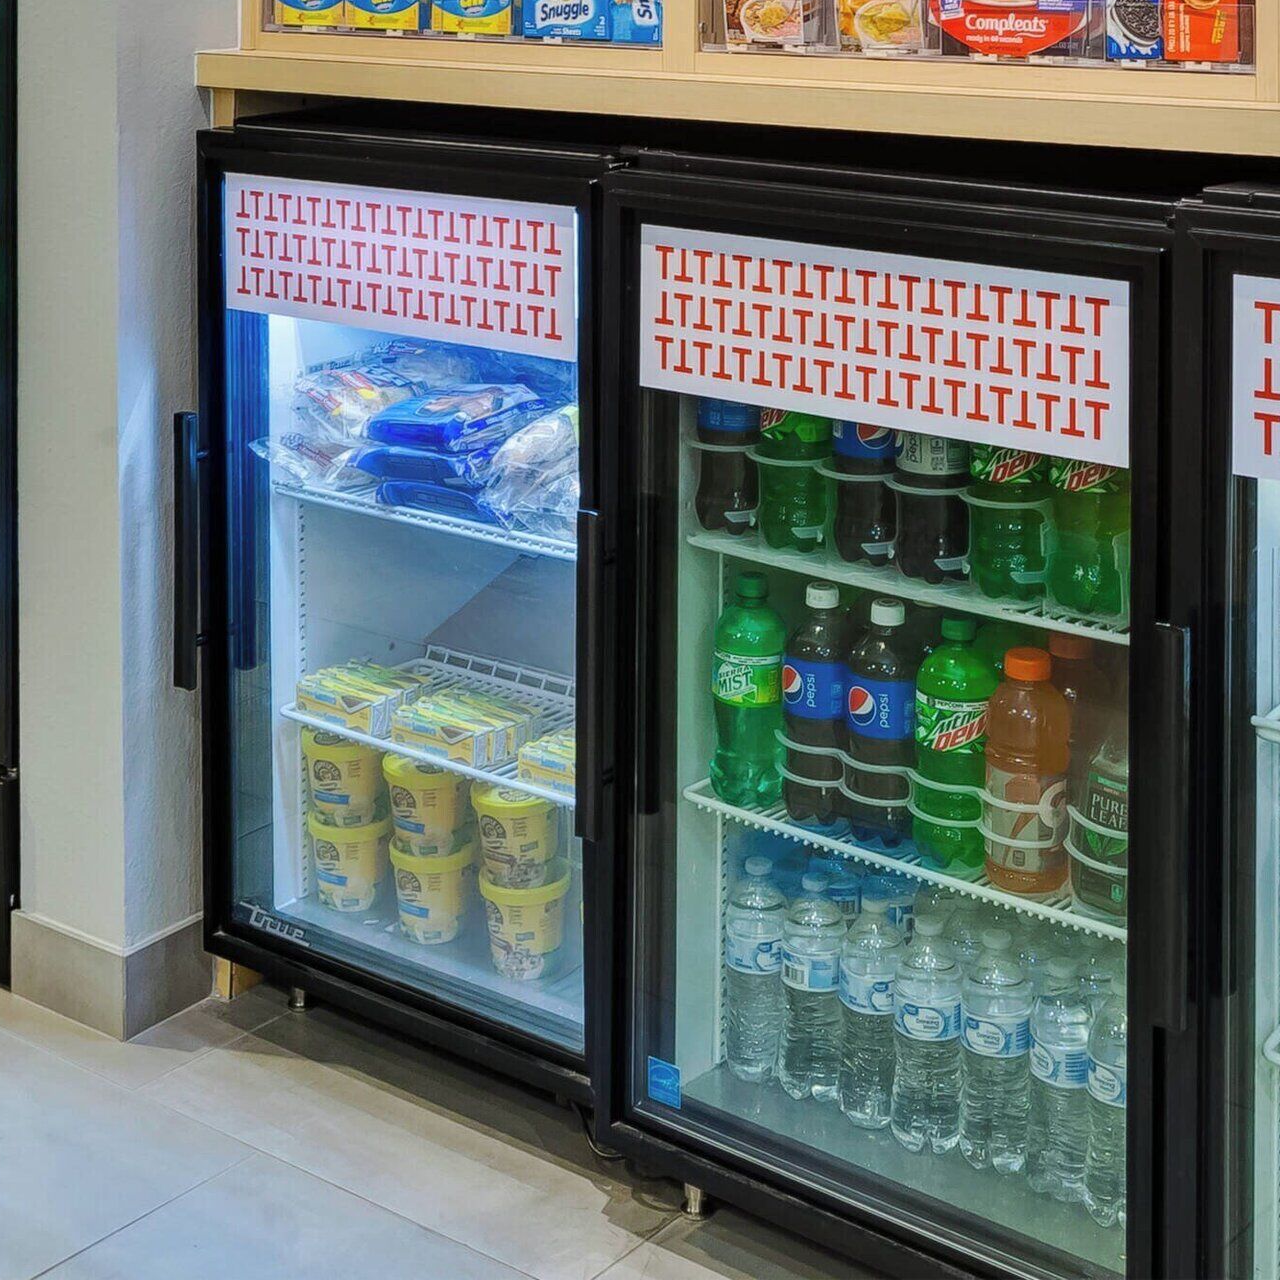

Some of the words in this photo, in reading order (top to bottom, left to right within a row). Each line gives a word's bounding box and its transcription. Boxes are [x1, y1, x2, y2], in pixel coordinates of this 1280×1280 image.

[540, 0, 590, 23] Snuggle
[965, 13, 1045, 36] Compleats
[719, 671, 753, 694] MIST
[806, 673, 817, 708] pepsi
[879, 693, 891, 729] pepsi
[1091, 793, 1129, 818] PURE
